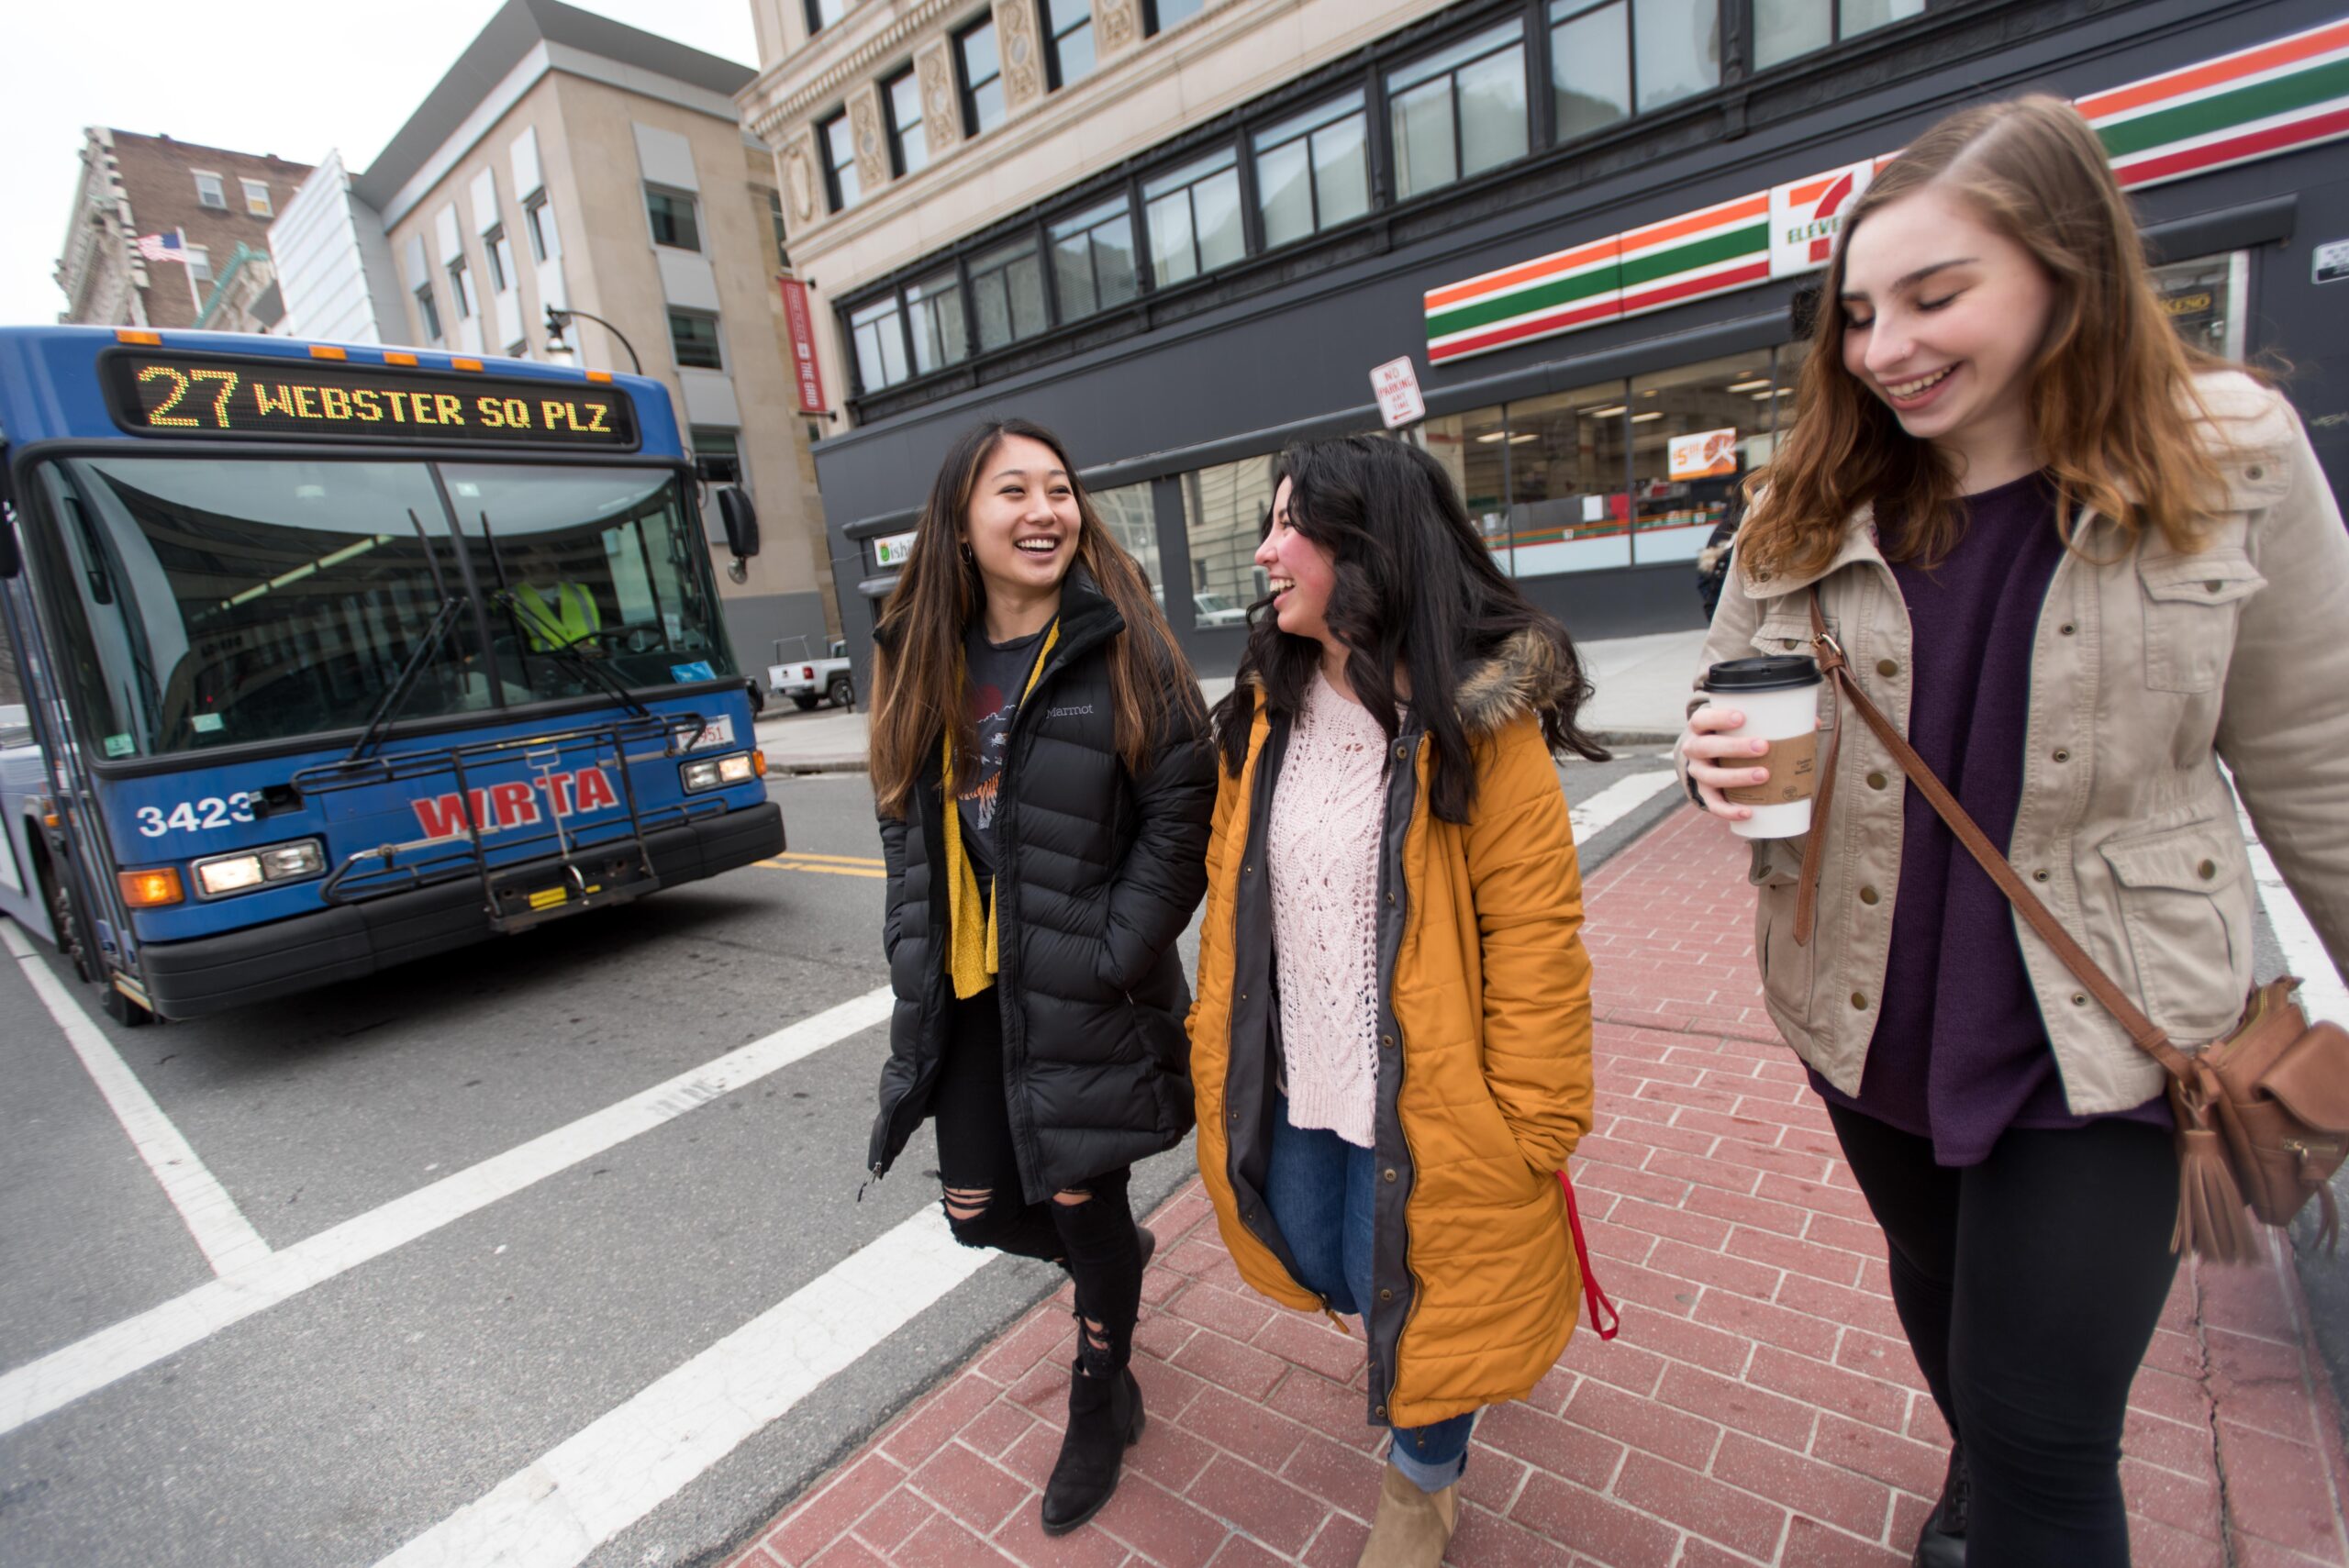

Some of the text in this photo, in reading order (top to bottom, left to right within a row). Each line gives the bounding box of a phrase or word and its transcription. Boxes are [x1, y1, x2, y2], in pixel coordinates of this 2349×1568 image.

[1378, 377, 1413, 396] PARKING
[1384, 367, 1399, 381] NO
[139, 366, 611, 432] 27 WEBSTER SQ PLZ
[1046, 704, 1094, 719] Marmot
[137, 791, 256, 838] 3423
[412, 766, 619, 839] WRTA
